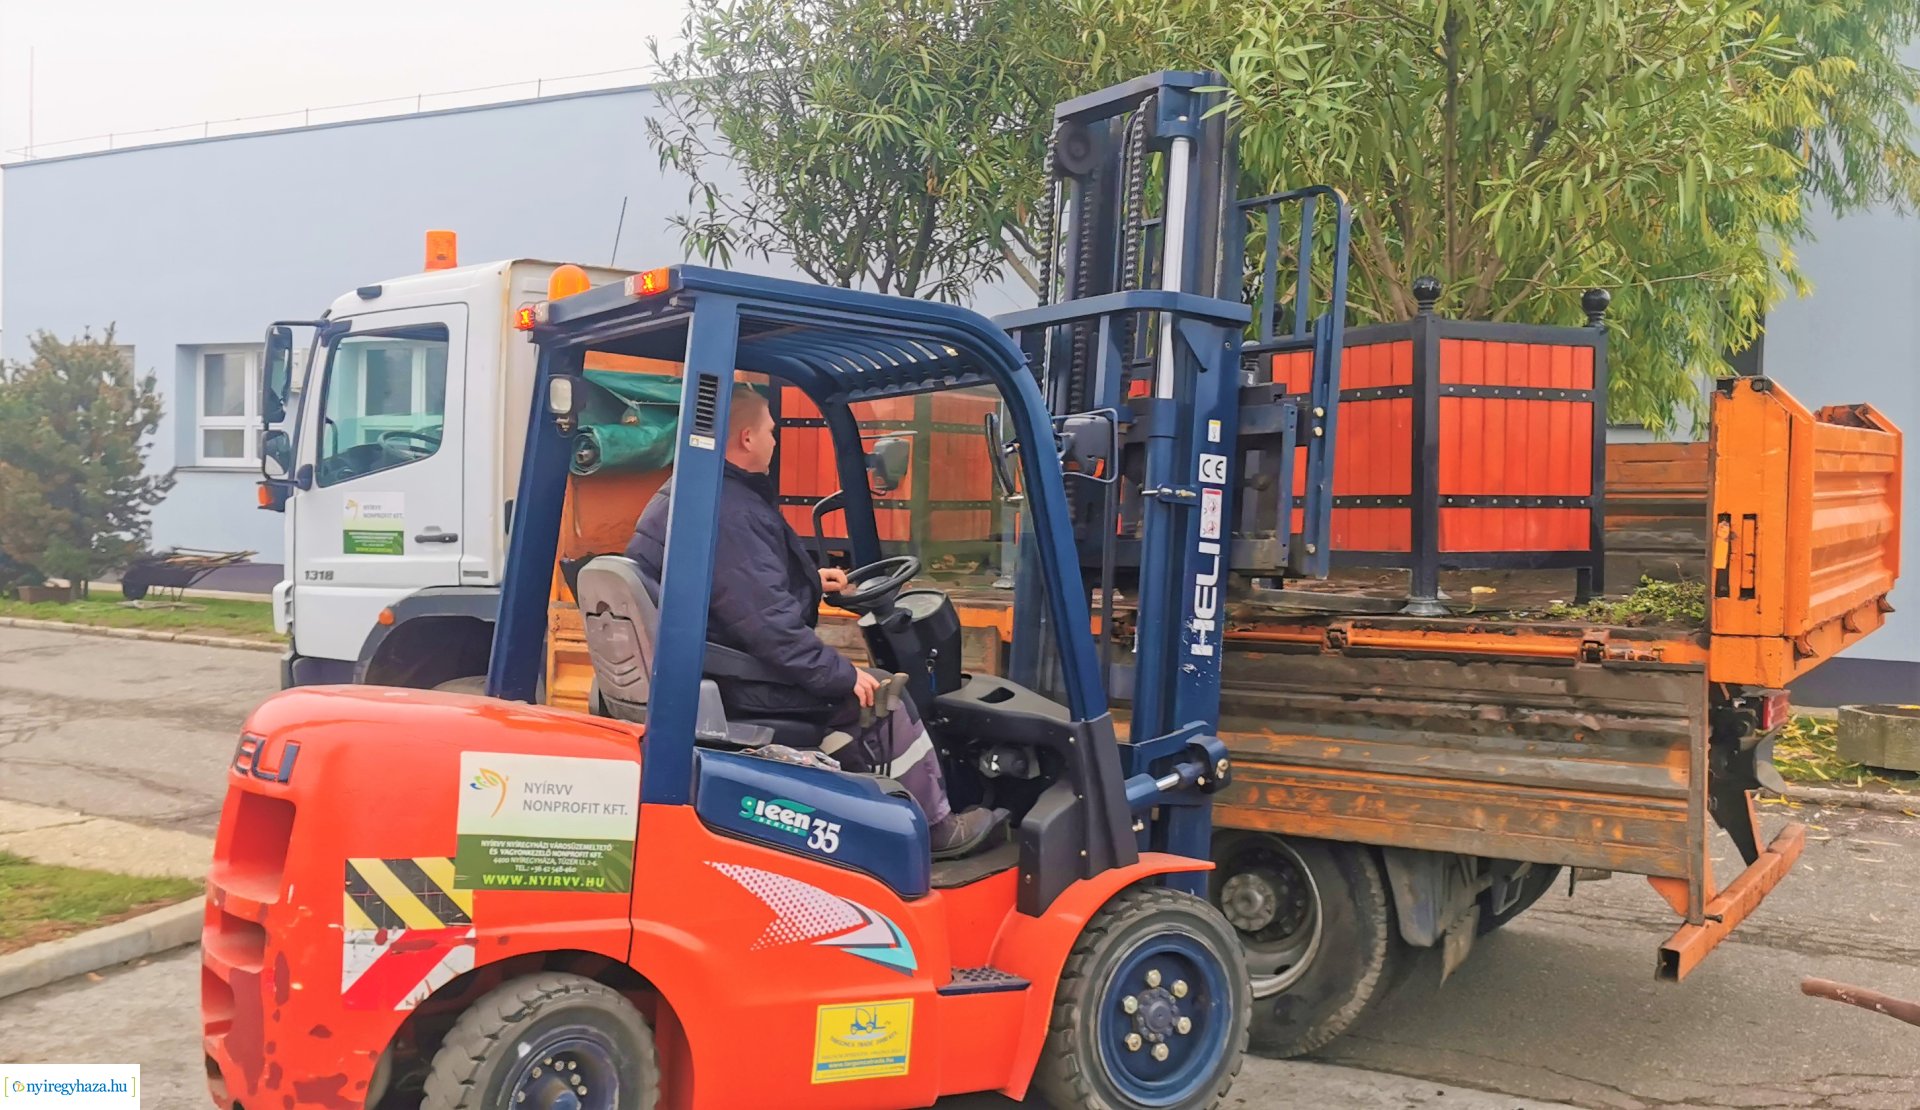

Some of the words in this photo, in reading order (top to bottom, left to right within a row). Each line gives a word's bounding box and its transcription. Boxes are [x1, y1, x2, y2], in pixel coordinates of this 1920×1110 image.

[304, 570, 335, 581] 1318
[1190, 541, 1221, 657] HELI
[523, 781, 573, 796] NYÍRVV
[522, 799, 600, 815] NONPROFIT
[602, 803, 628, 816] KFT.
[806, 818, 842, 854] 35
[482, 873, 606, 889] WWW.NYIRVV.HU
